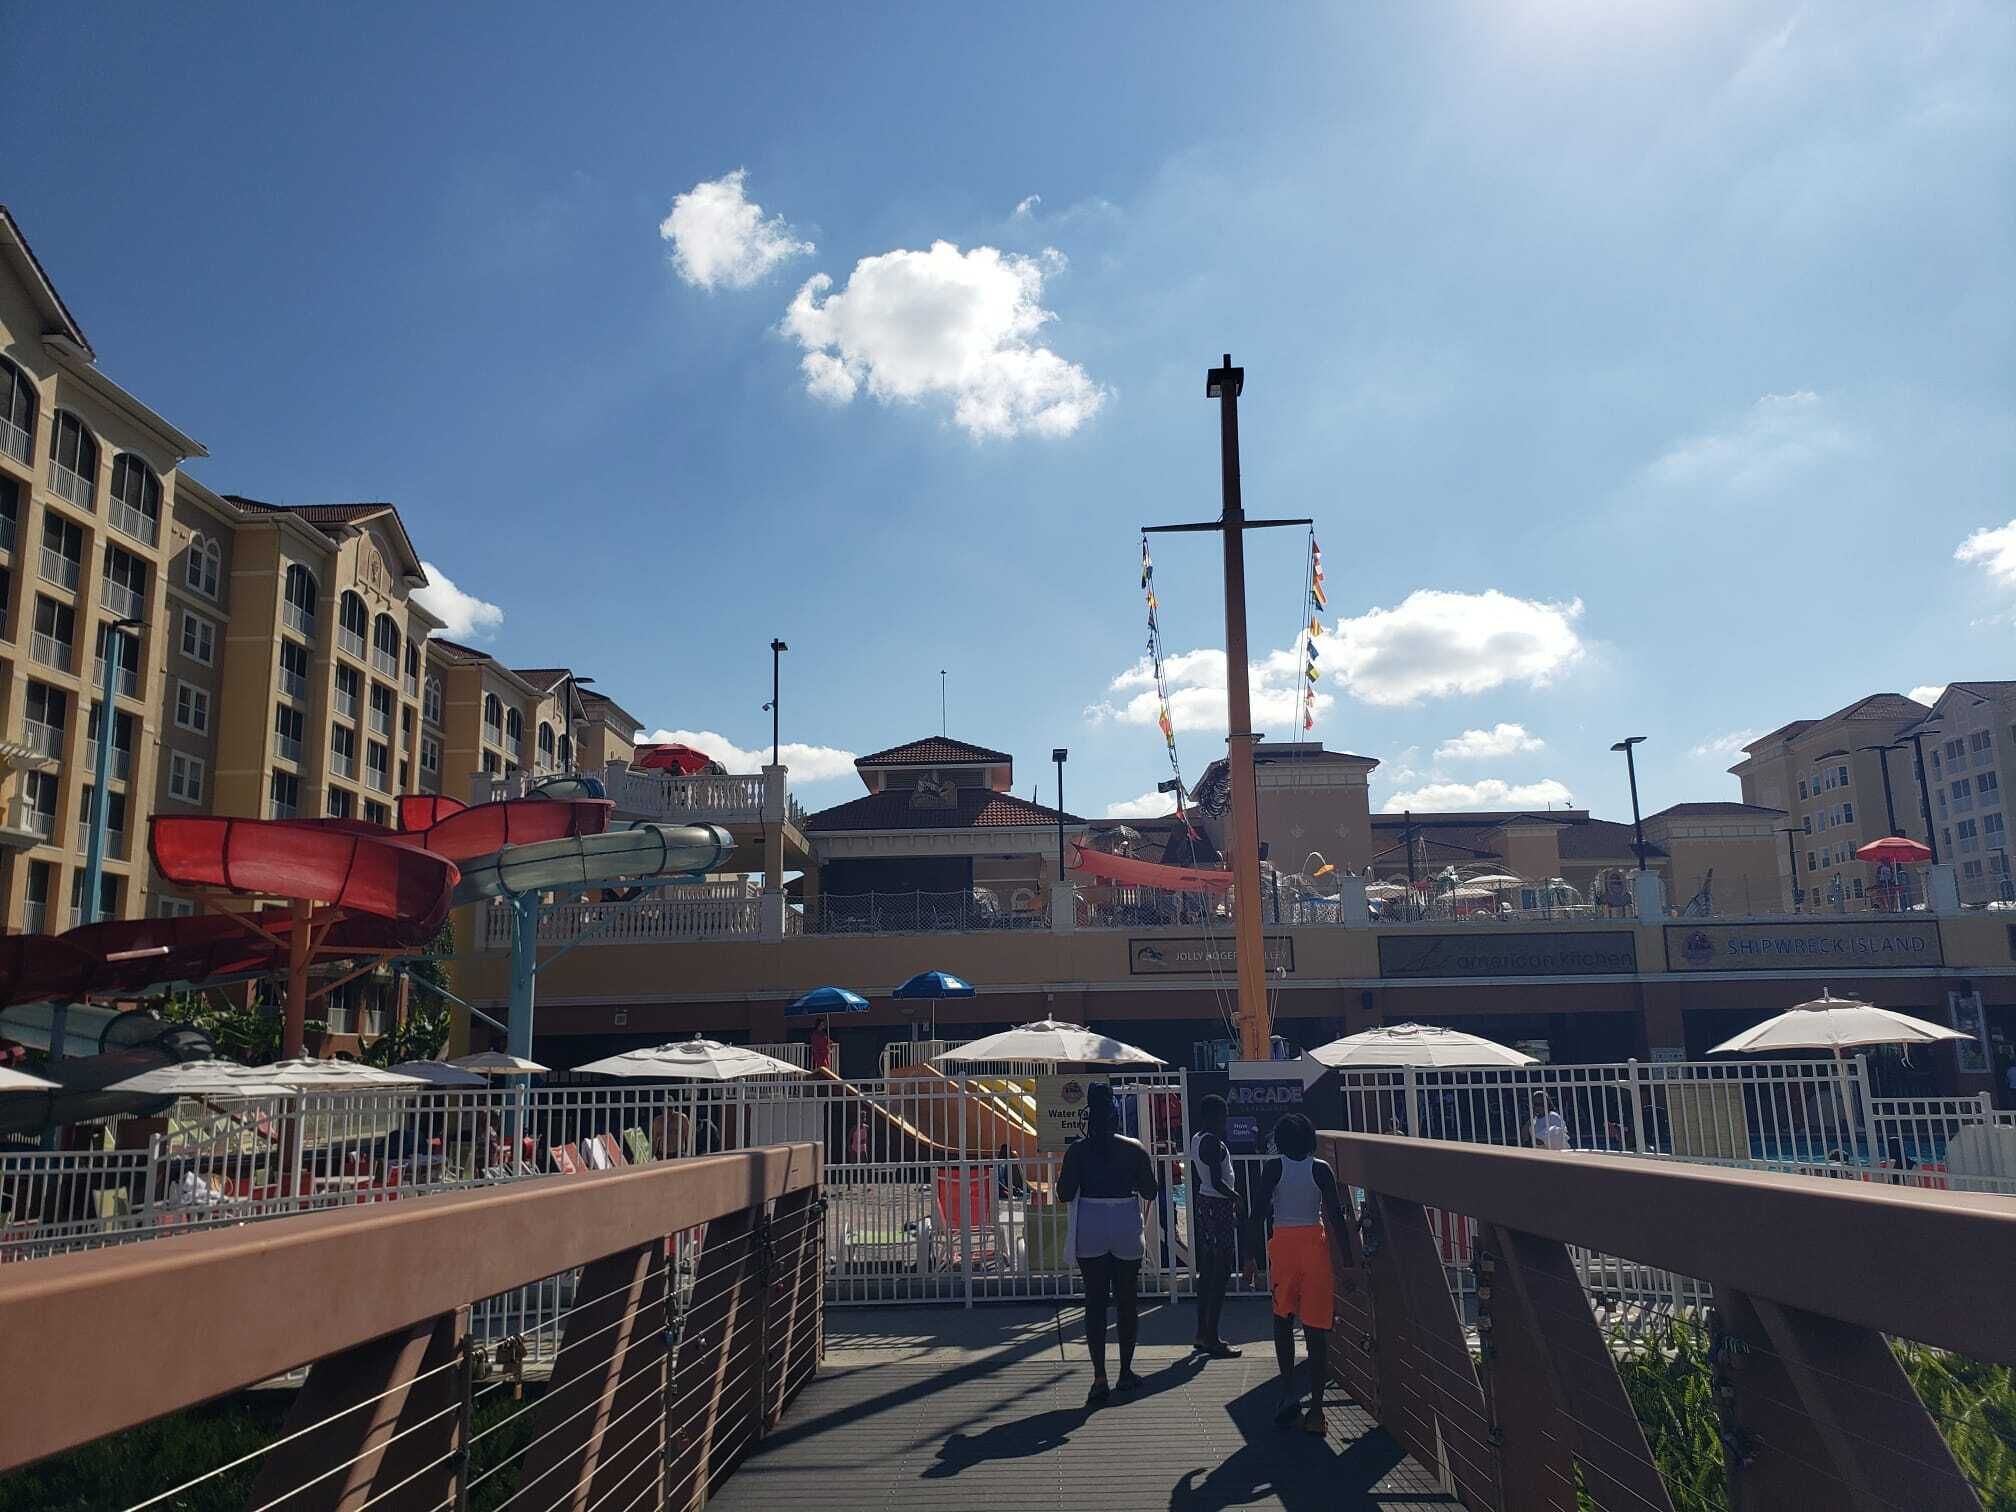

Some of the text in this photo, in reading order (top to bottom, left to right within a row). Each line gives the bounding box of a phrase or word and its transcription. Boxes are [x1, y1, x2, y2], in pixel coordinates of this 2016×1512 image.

[1727, 937, 1844, 955] SHIPWRECK
[1850, 936, 1925, 953] ISLAND
[1175, 951, 1203, 961] JOLLY
[1226, 1086, 1304, 1104] ARCADE
[1048, 1109, 1075, 1118] Water
[1061, 1120, 1086, 1130] Entry
